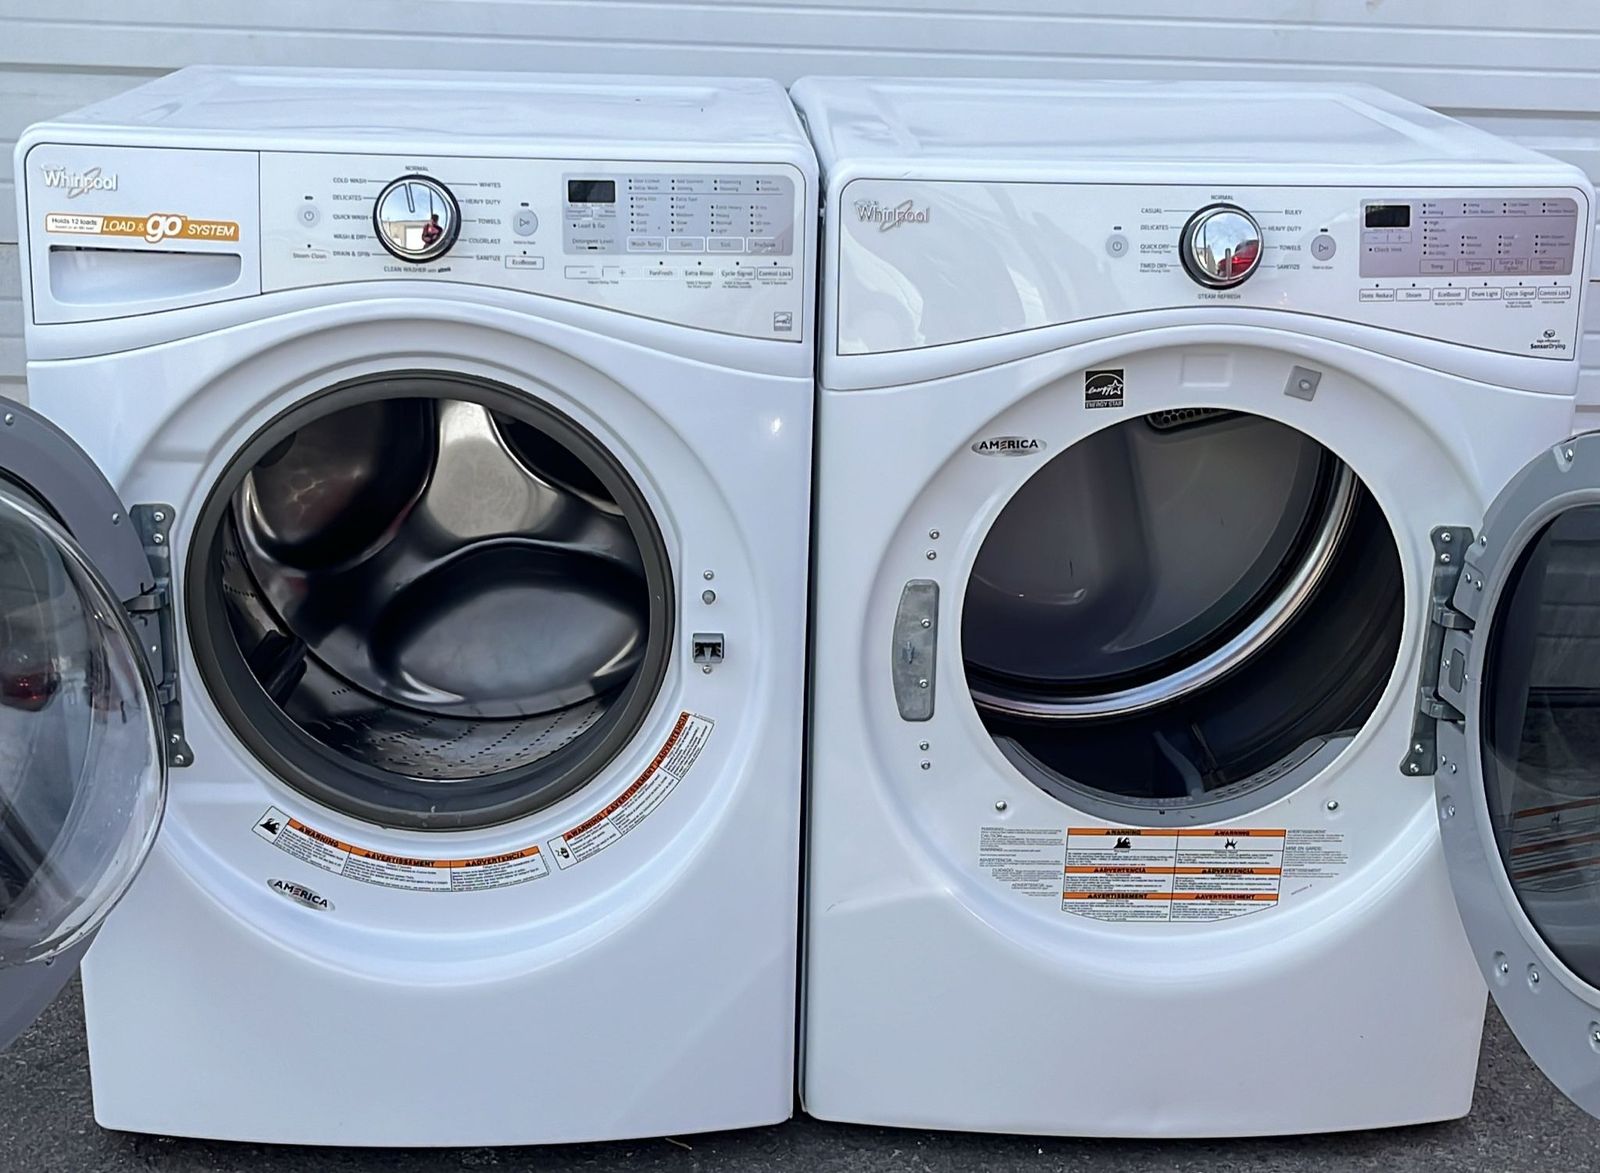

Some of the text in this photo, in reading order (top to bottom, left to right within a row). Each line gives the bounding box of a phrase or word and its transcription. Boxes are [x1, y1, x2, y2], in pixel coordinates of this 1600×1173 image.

[43, 164, 118, 197] Whirlpool
[855, 201, 930, 230] Whirlpool
[103, 214, 236, 243] LOAD & go SYSTEM
[978, 438, 1039, 451] AMERICA
[303, 826, 339, 848] WARNING
[371, 853, 436, 868] AVERTISSEMENT
[471, 853, 526, 867] ADVERTENCIA
[273, 880, 329, 909] AMERICA
